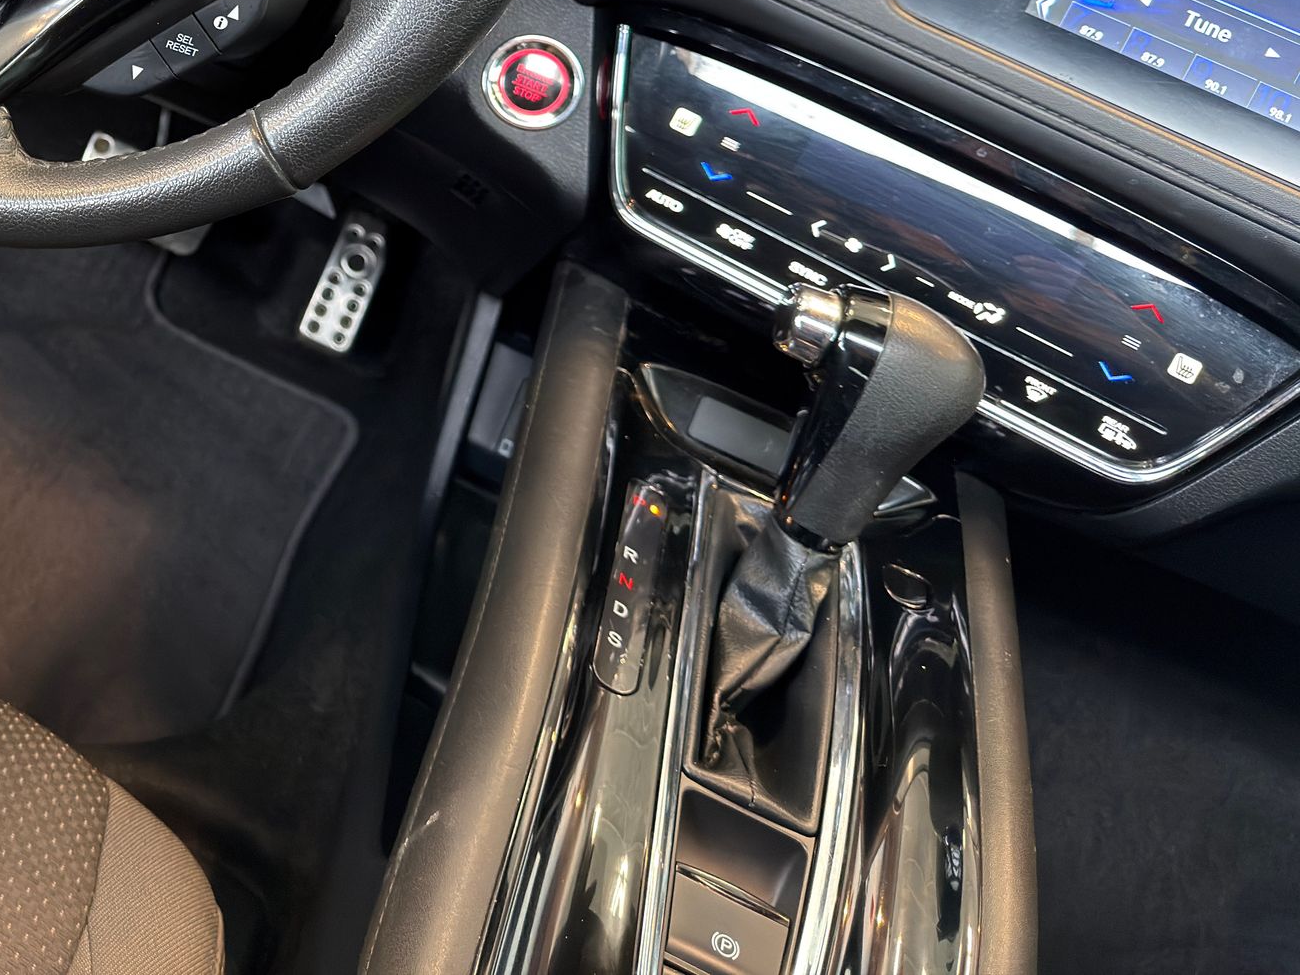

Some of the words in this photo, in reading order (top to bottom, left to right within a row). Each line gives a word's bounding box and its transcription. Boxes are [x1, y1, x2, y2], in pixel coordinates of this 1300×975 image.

[1078, 24, 1104, 42] 87.9
[1183, 10, 1232, 43] Tune
[165, 40, 199, 57] RESET
[176, 33, 194, 46] SEL
[1140, 51, 1166, 69] 87.9
[516, 73, 549, 93] START
[1204, 78, 1228, 96] 90.1
[513, 85, 542, 103] STOP
[1268, 106, 1293, 124] 98.1
[645, 188, 684, 213] AUTO
[1102, 415, 1131, 433] REAR
[623, 545, 639, 565] R
[619, 572, 634, 590] N
[613, 600, 629, 618] D
[607, 630, 623, 648] S
